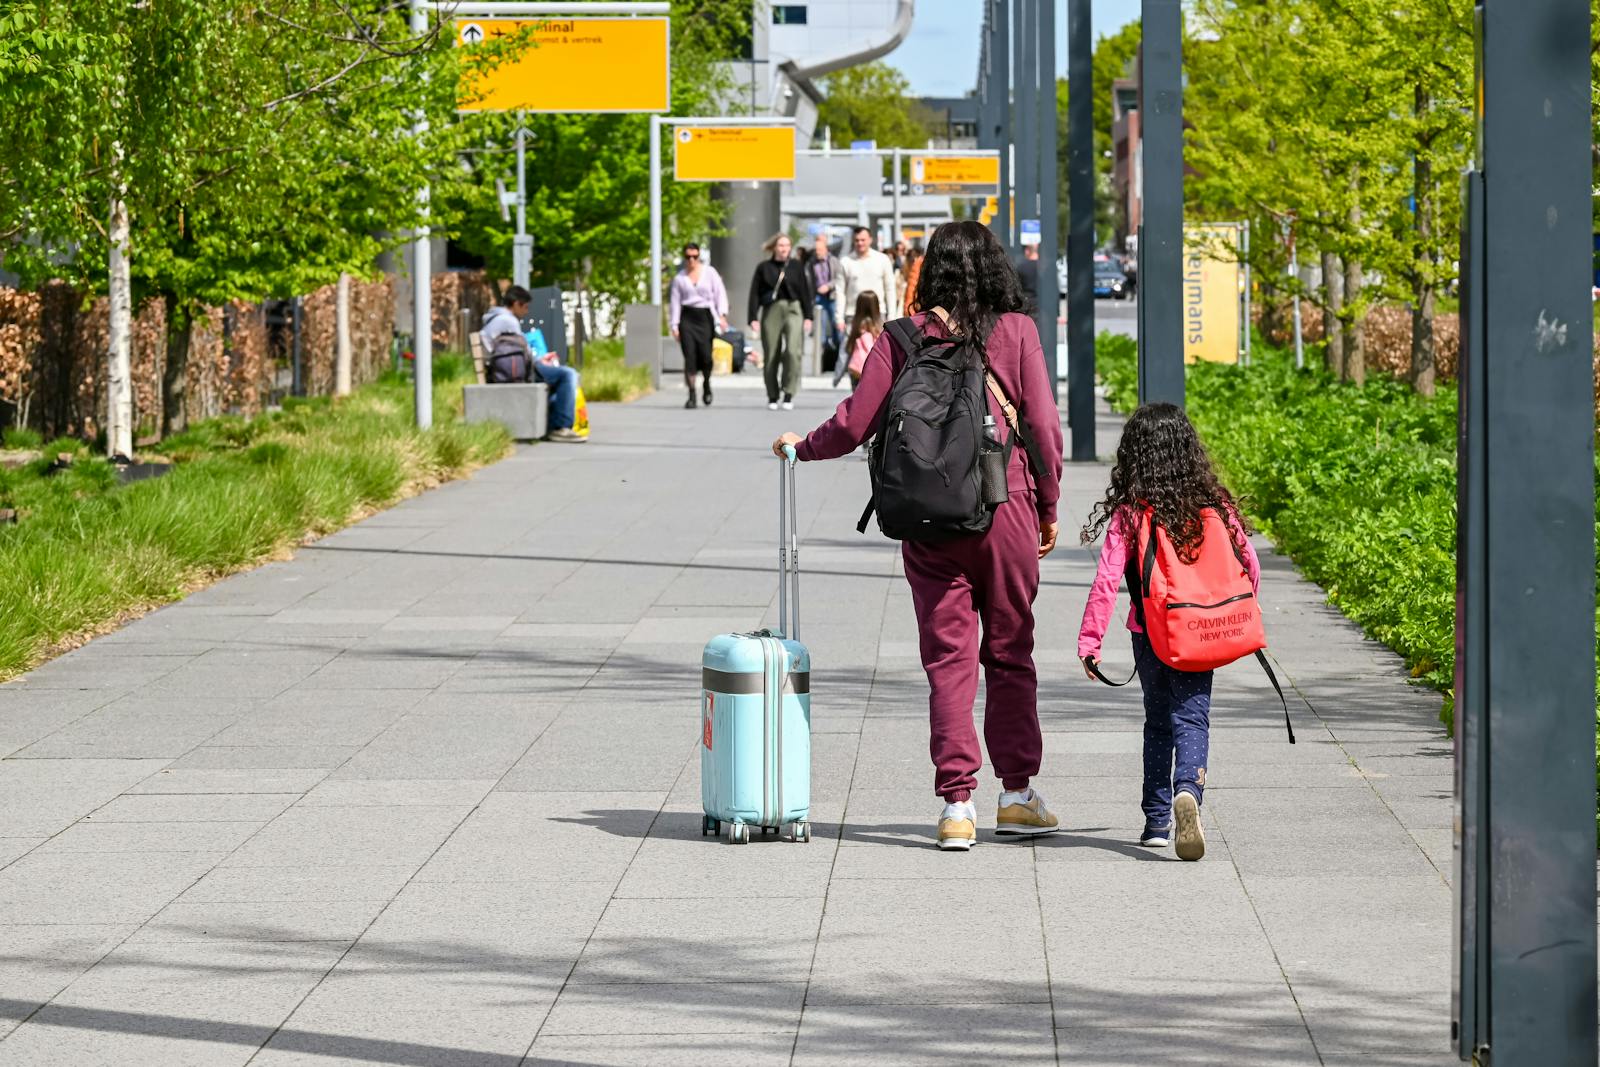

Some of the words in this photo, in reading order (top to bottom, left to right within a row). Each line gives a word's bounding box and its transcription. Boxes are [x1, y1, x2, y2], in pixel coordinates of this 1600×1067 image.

[514, 20, 575, 32] Teminal
[1187, 616, 1226, 631] CALVIN
[1227, 612, 1252, 625] KLEIN
[1199, 631, 1221, 642] NEW
[1222, 627, 1245, 639] YORK
